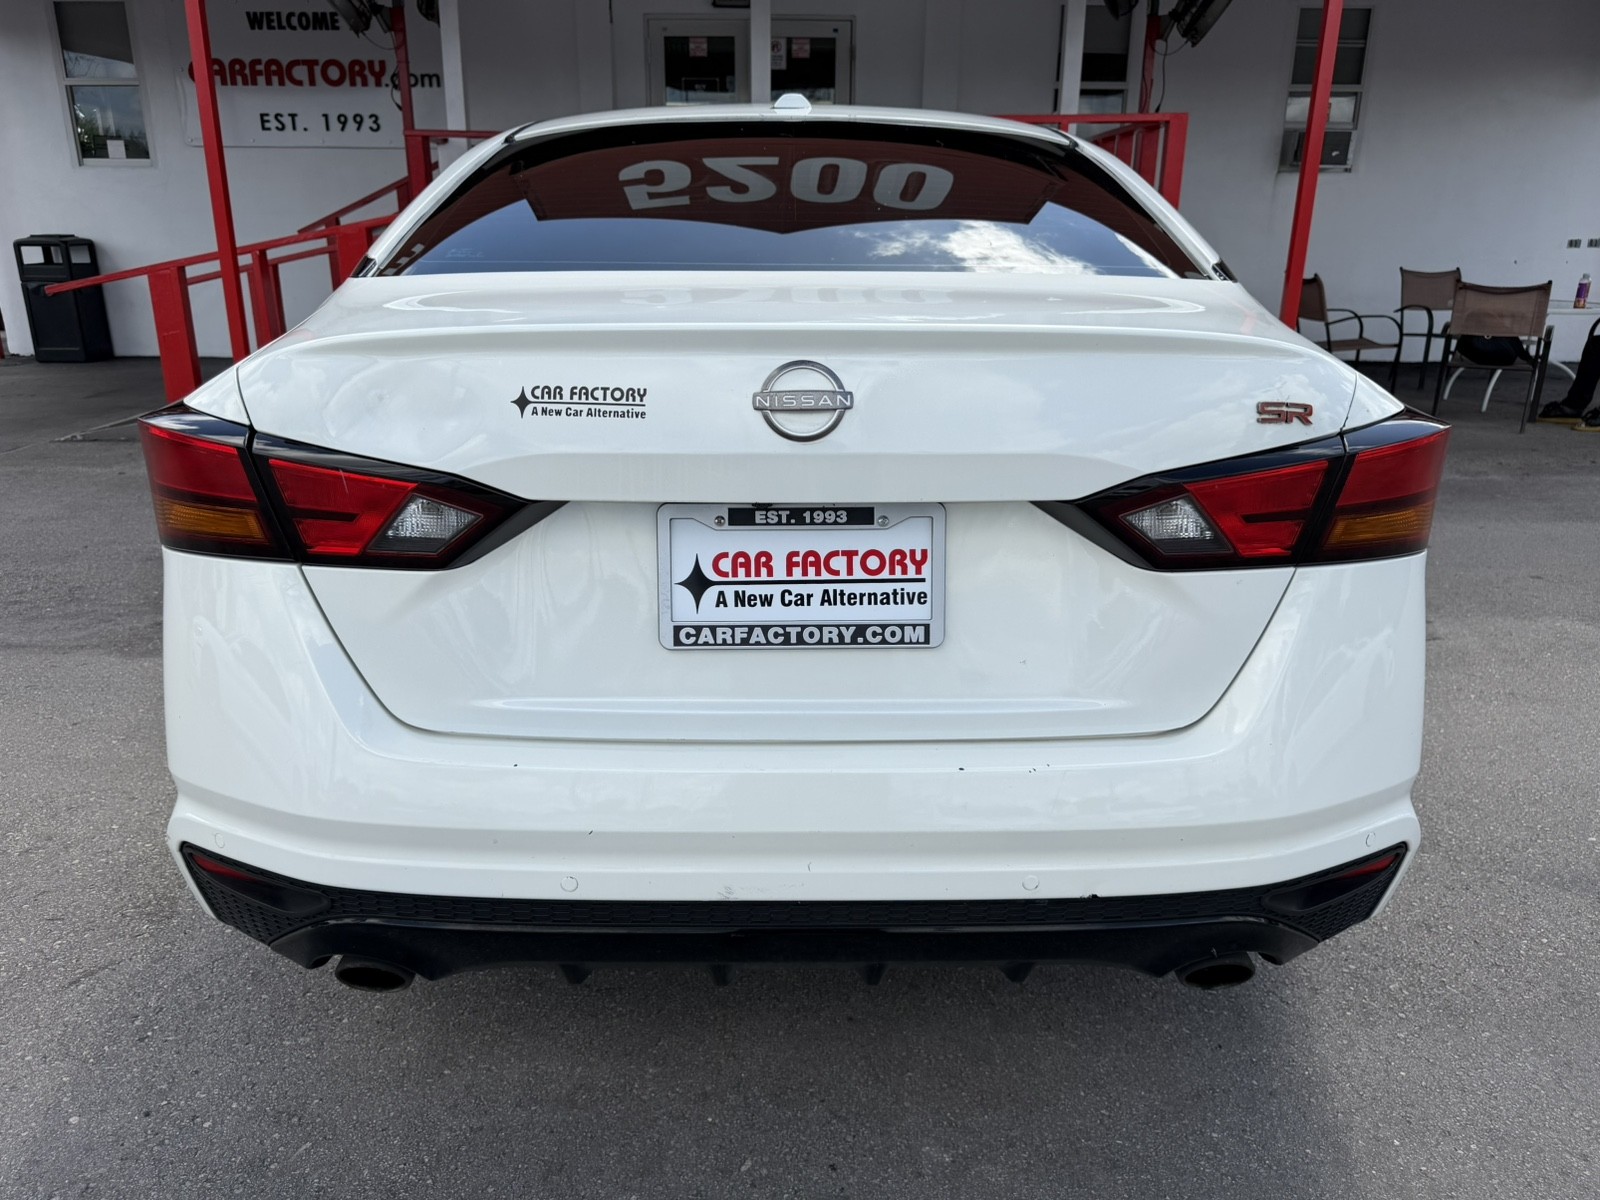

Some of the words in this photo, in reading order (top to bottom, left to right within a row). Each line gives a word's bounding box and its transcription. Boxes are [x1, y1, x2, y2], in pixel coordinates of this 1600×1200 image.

[246, 11, 341, 31] WELCOME
[259, 113, 309, 133] EST.
[321, 113, 382, 133] 1993
[530, 385, 564, 400] CAR
[569, 386, 648, 403] FACTORY
[755, 394, 852, 408] NISSAN
[531, 406, 539, 417] A
[541, 406, 562, 417] New
[565, 407, 584, 418] Car
[586, 407, 647, 420] Alternative
[1256, 401, 1314, 425] SR
[754, 510, 796, 524] EST.
[803, 509, 848, 524] 1993
[711, 550, 774, 579] CAR
[785, 548, 929, 578] FACTORY
[714, 590, 729, 608] A
[734, 589, 774, 608] New
[780, 588, 814, 607] Car
[819, 587, 929, 607] Alternative
[678, 625, 926, 645] CARFACTORY.COM
